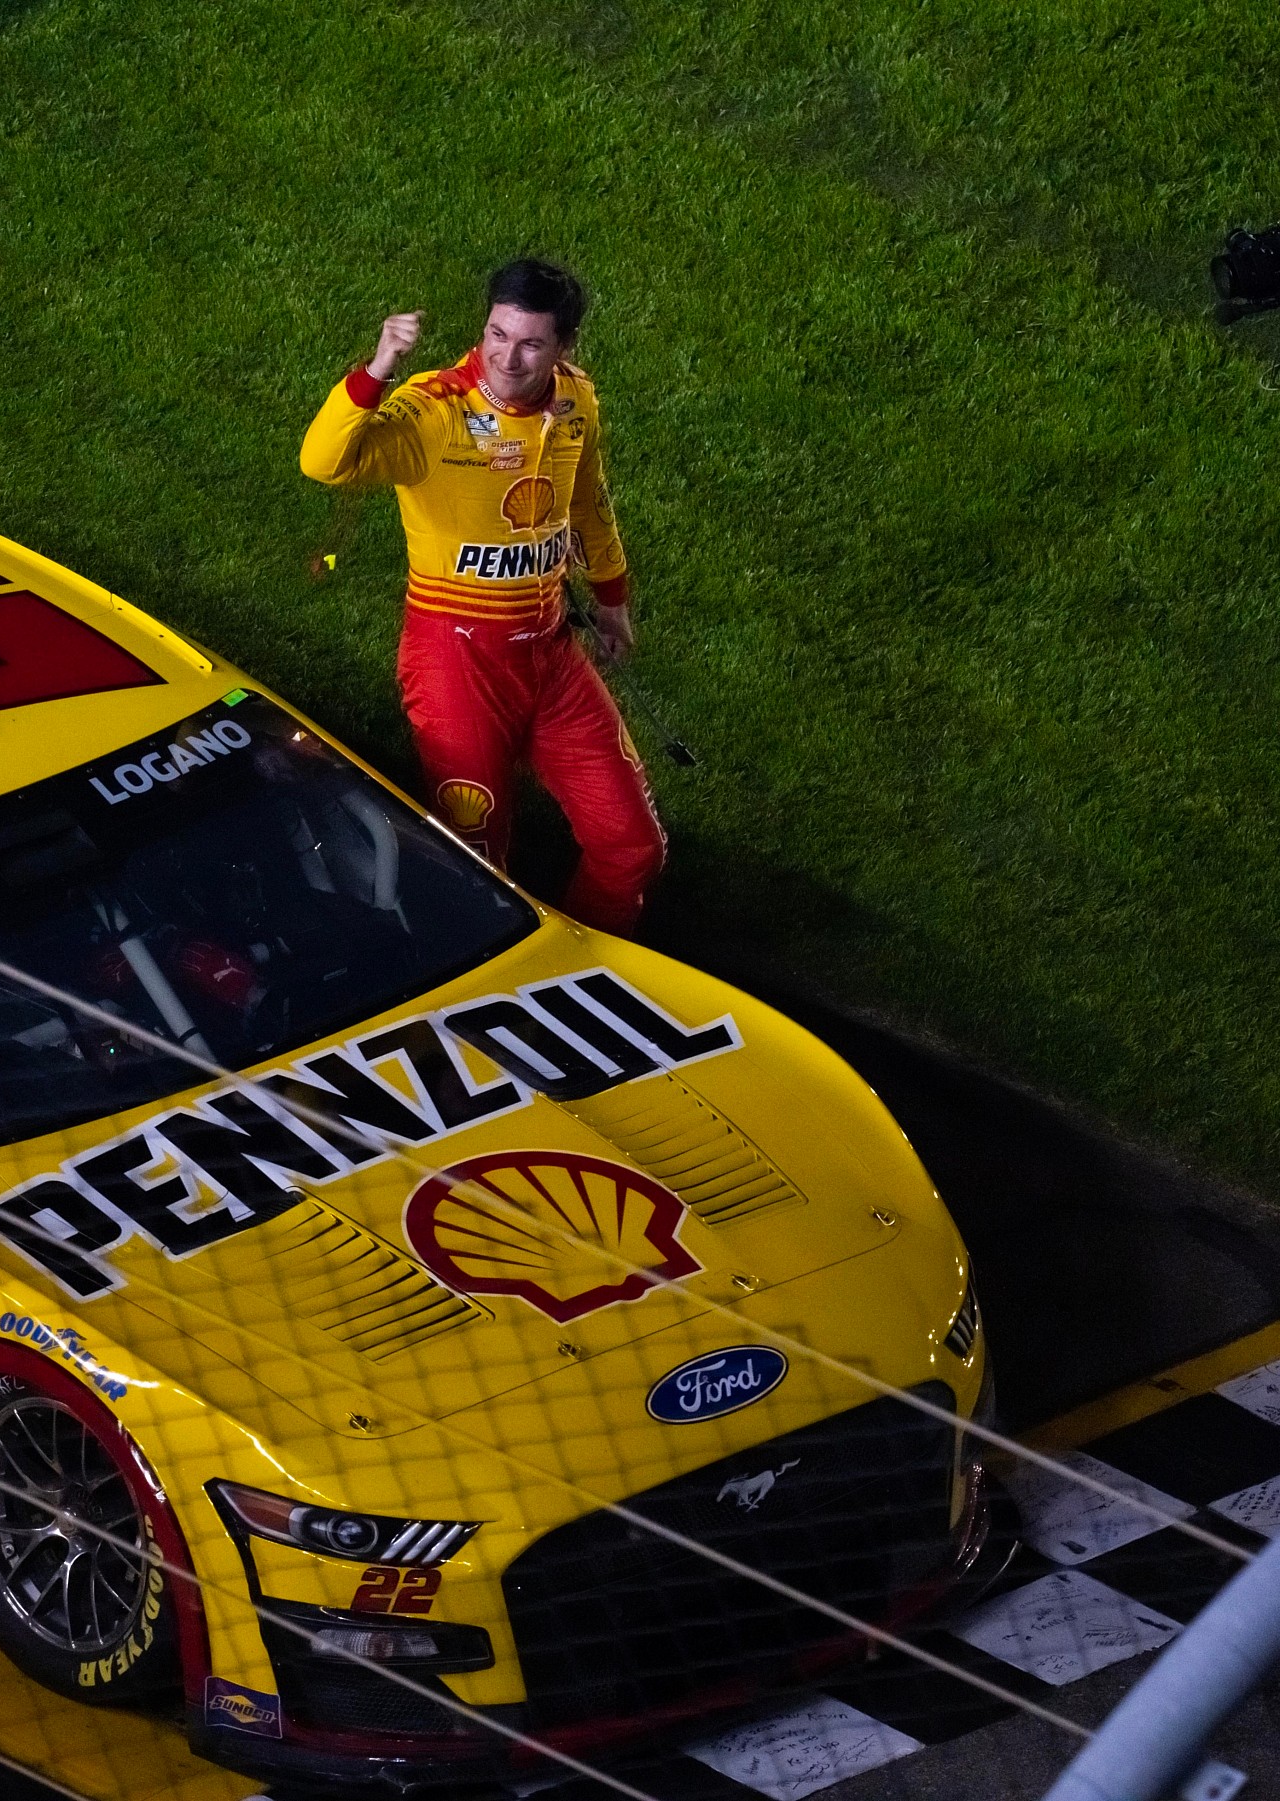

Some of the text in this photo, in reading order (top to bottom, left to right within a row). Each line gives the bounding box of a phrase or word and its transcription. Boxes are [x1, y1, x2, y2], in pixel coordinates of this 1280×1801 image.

[477, 378, 507, 411] PENNZOIL
[442, 457, 488, 467] GOODYEAR
[456, 527, 568, 578] PENNZO
[87, 718, 254, 805] LOGANO
[672, 1355, 763, 1413] Ford
[350, 1567, 442, 1614] 22
[213, 1696, 274, 1722] SUNOCO
